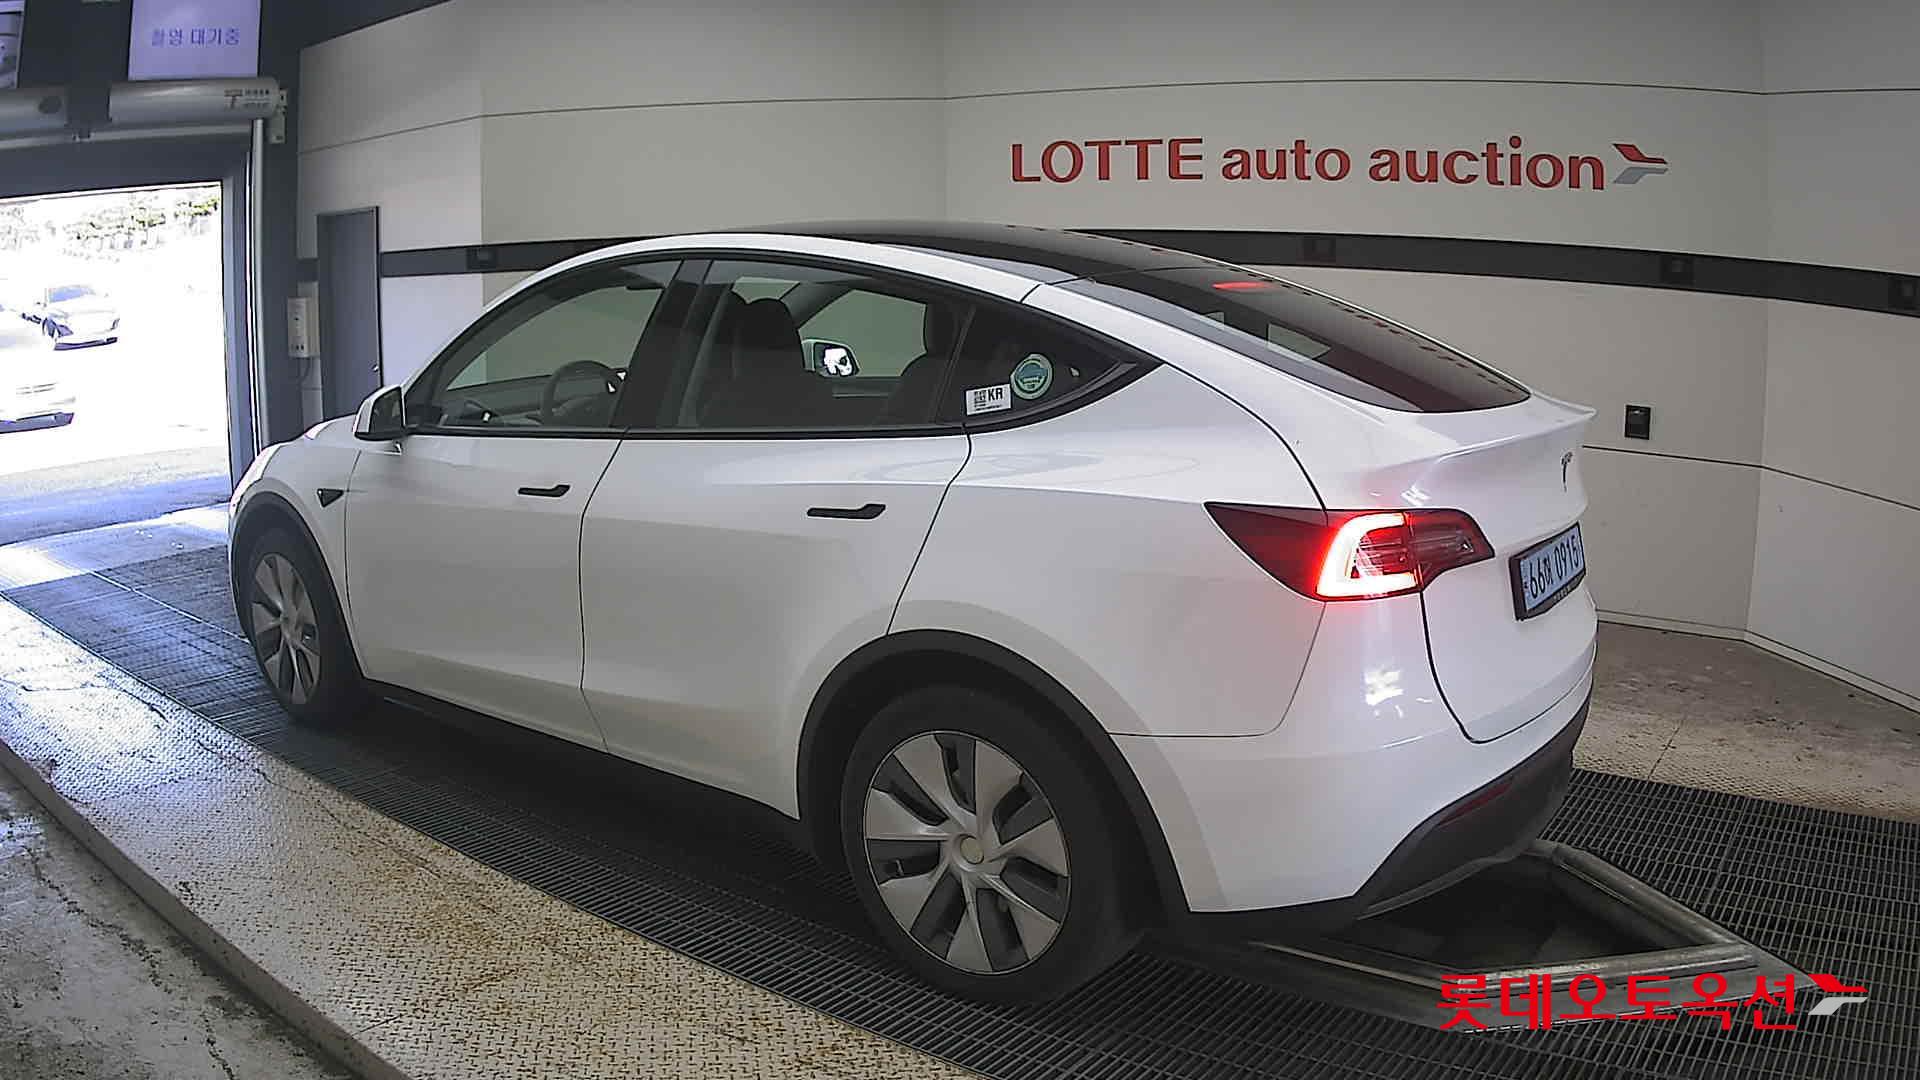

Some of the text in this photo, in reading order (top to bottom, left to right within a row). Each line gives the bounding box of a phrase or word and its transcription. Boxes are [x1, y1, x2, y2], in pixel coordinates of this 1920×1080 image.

[1011, 136, 1605, 190] LOTTE auto auction
[987, 387, 1003, 402] KR
[1554, 534, 1579, 581] 0915
